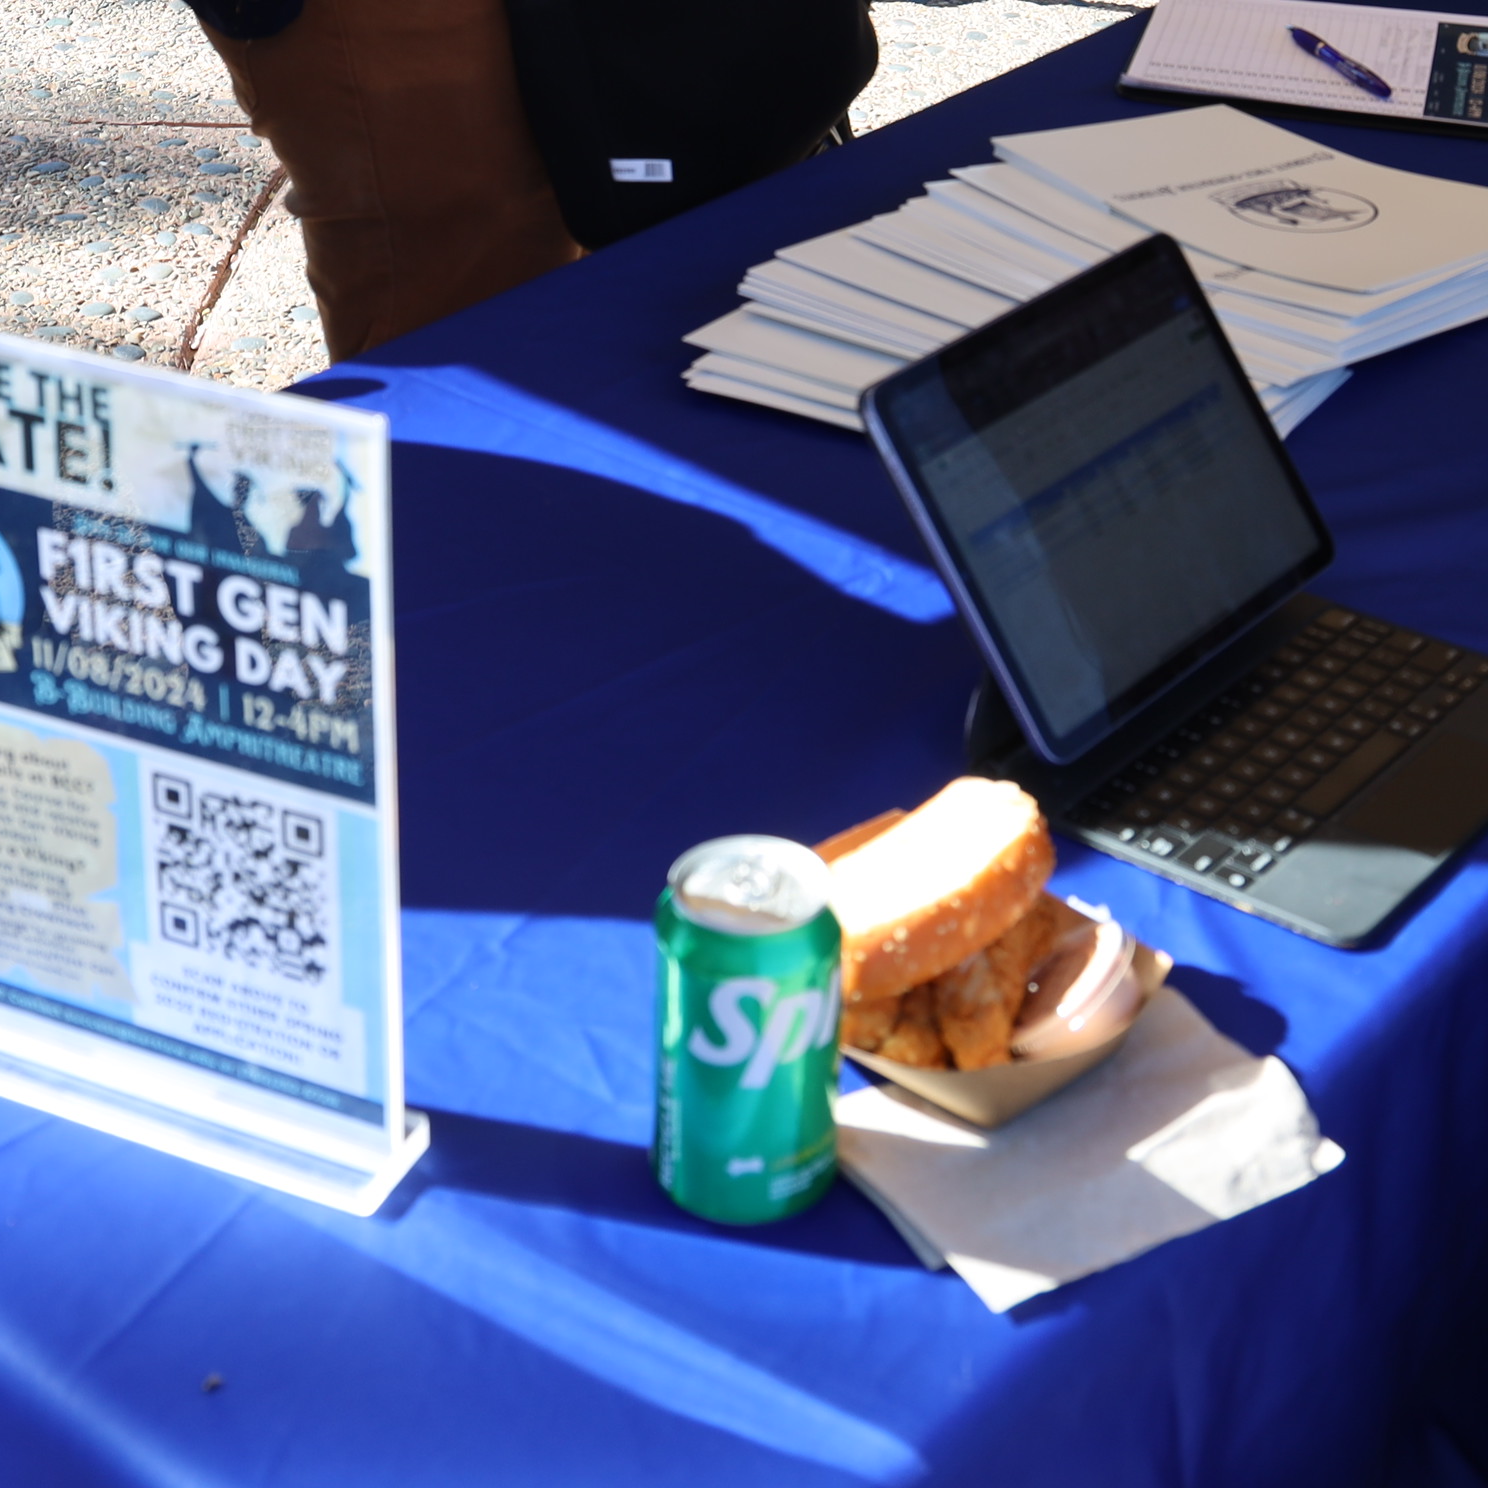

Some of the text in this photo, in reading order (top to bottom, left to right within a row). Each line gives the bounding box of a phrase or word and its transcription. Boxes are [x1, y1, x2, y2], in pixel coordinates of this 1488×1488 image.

[28, 370, 110, 424] THE
[38, 583, 225, 674] VIKING
[234, 634, 350, 706] DAY
[216, 573, 349, 656] GEN
[30, 635, 208, 713] 11/08/2024
[241, 691, 360, 755] 12-4PM
